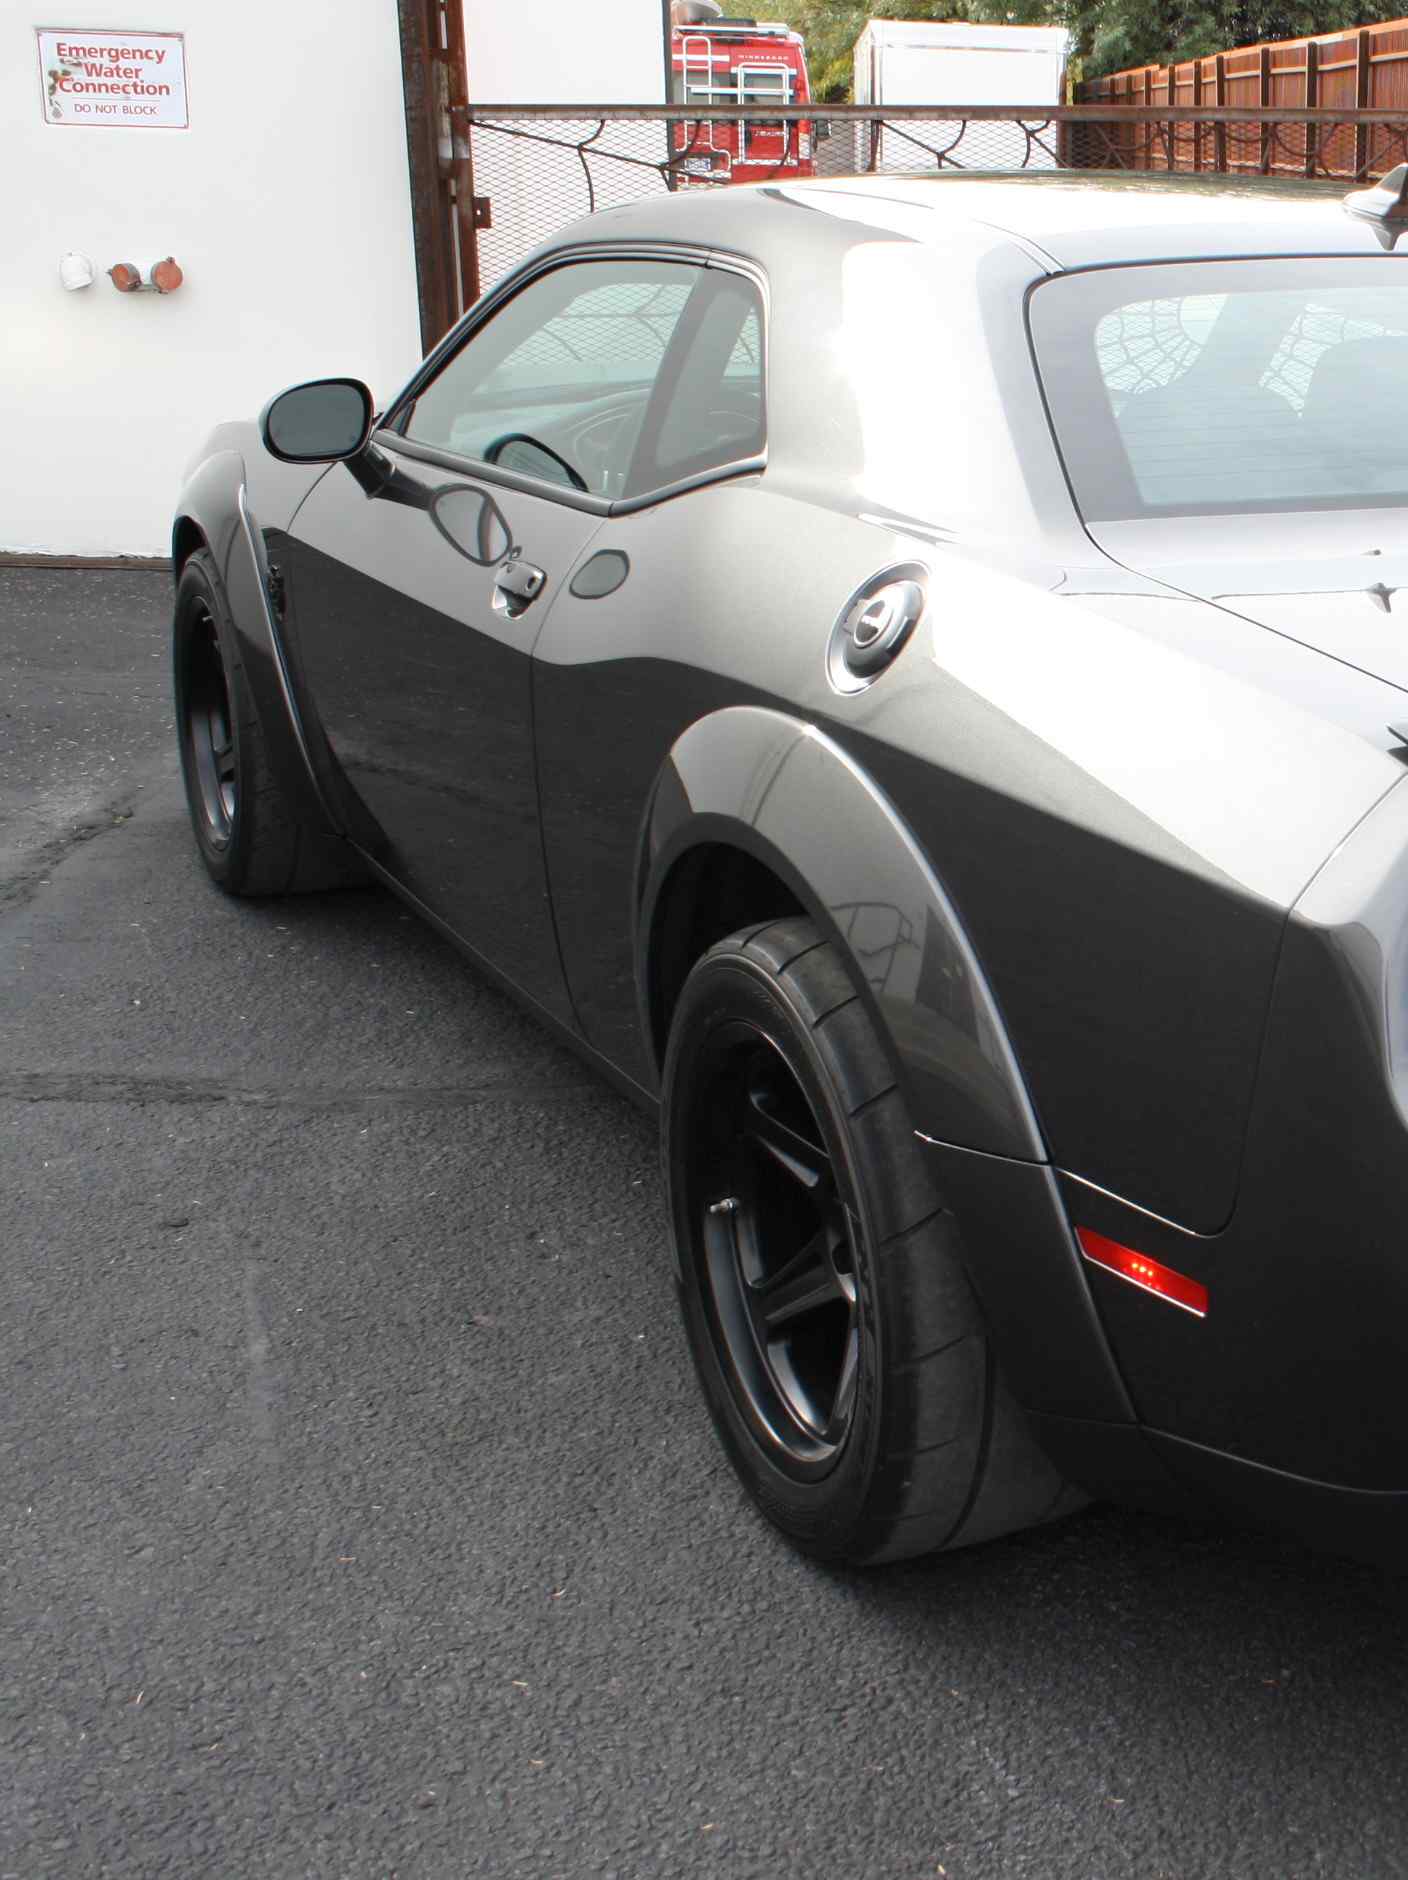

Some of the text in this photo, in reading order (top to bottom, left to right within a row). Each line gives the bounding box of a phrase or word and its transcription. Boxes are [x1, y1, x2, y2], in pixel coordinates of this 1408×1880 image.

[56, 42, 166, 64] Emergency
[84, 63, 143, 79] Water
[58, 78, 170, 96] Connection
[74, 103, 157, 115] DO NOT BLOCK
